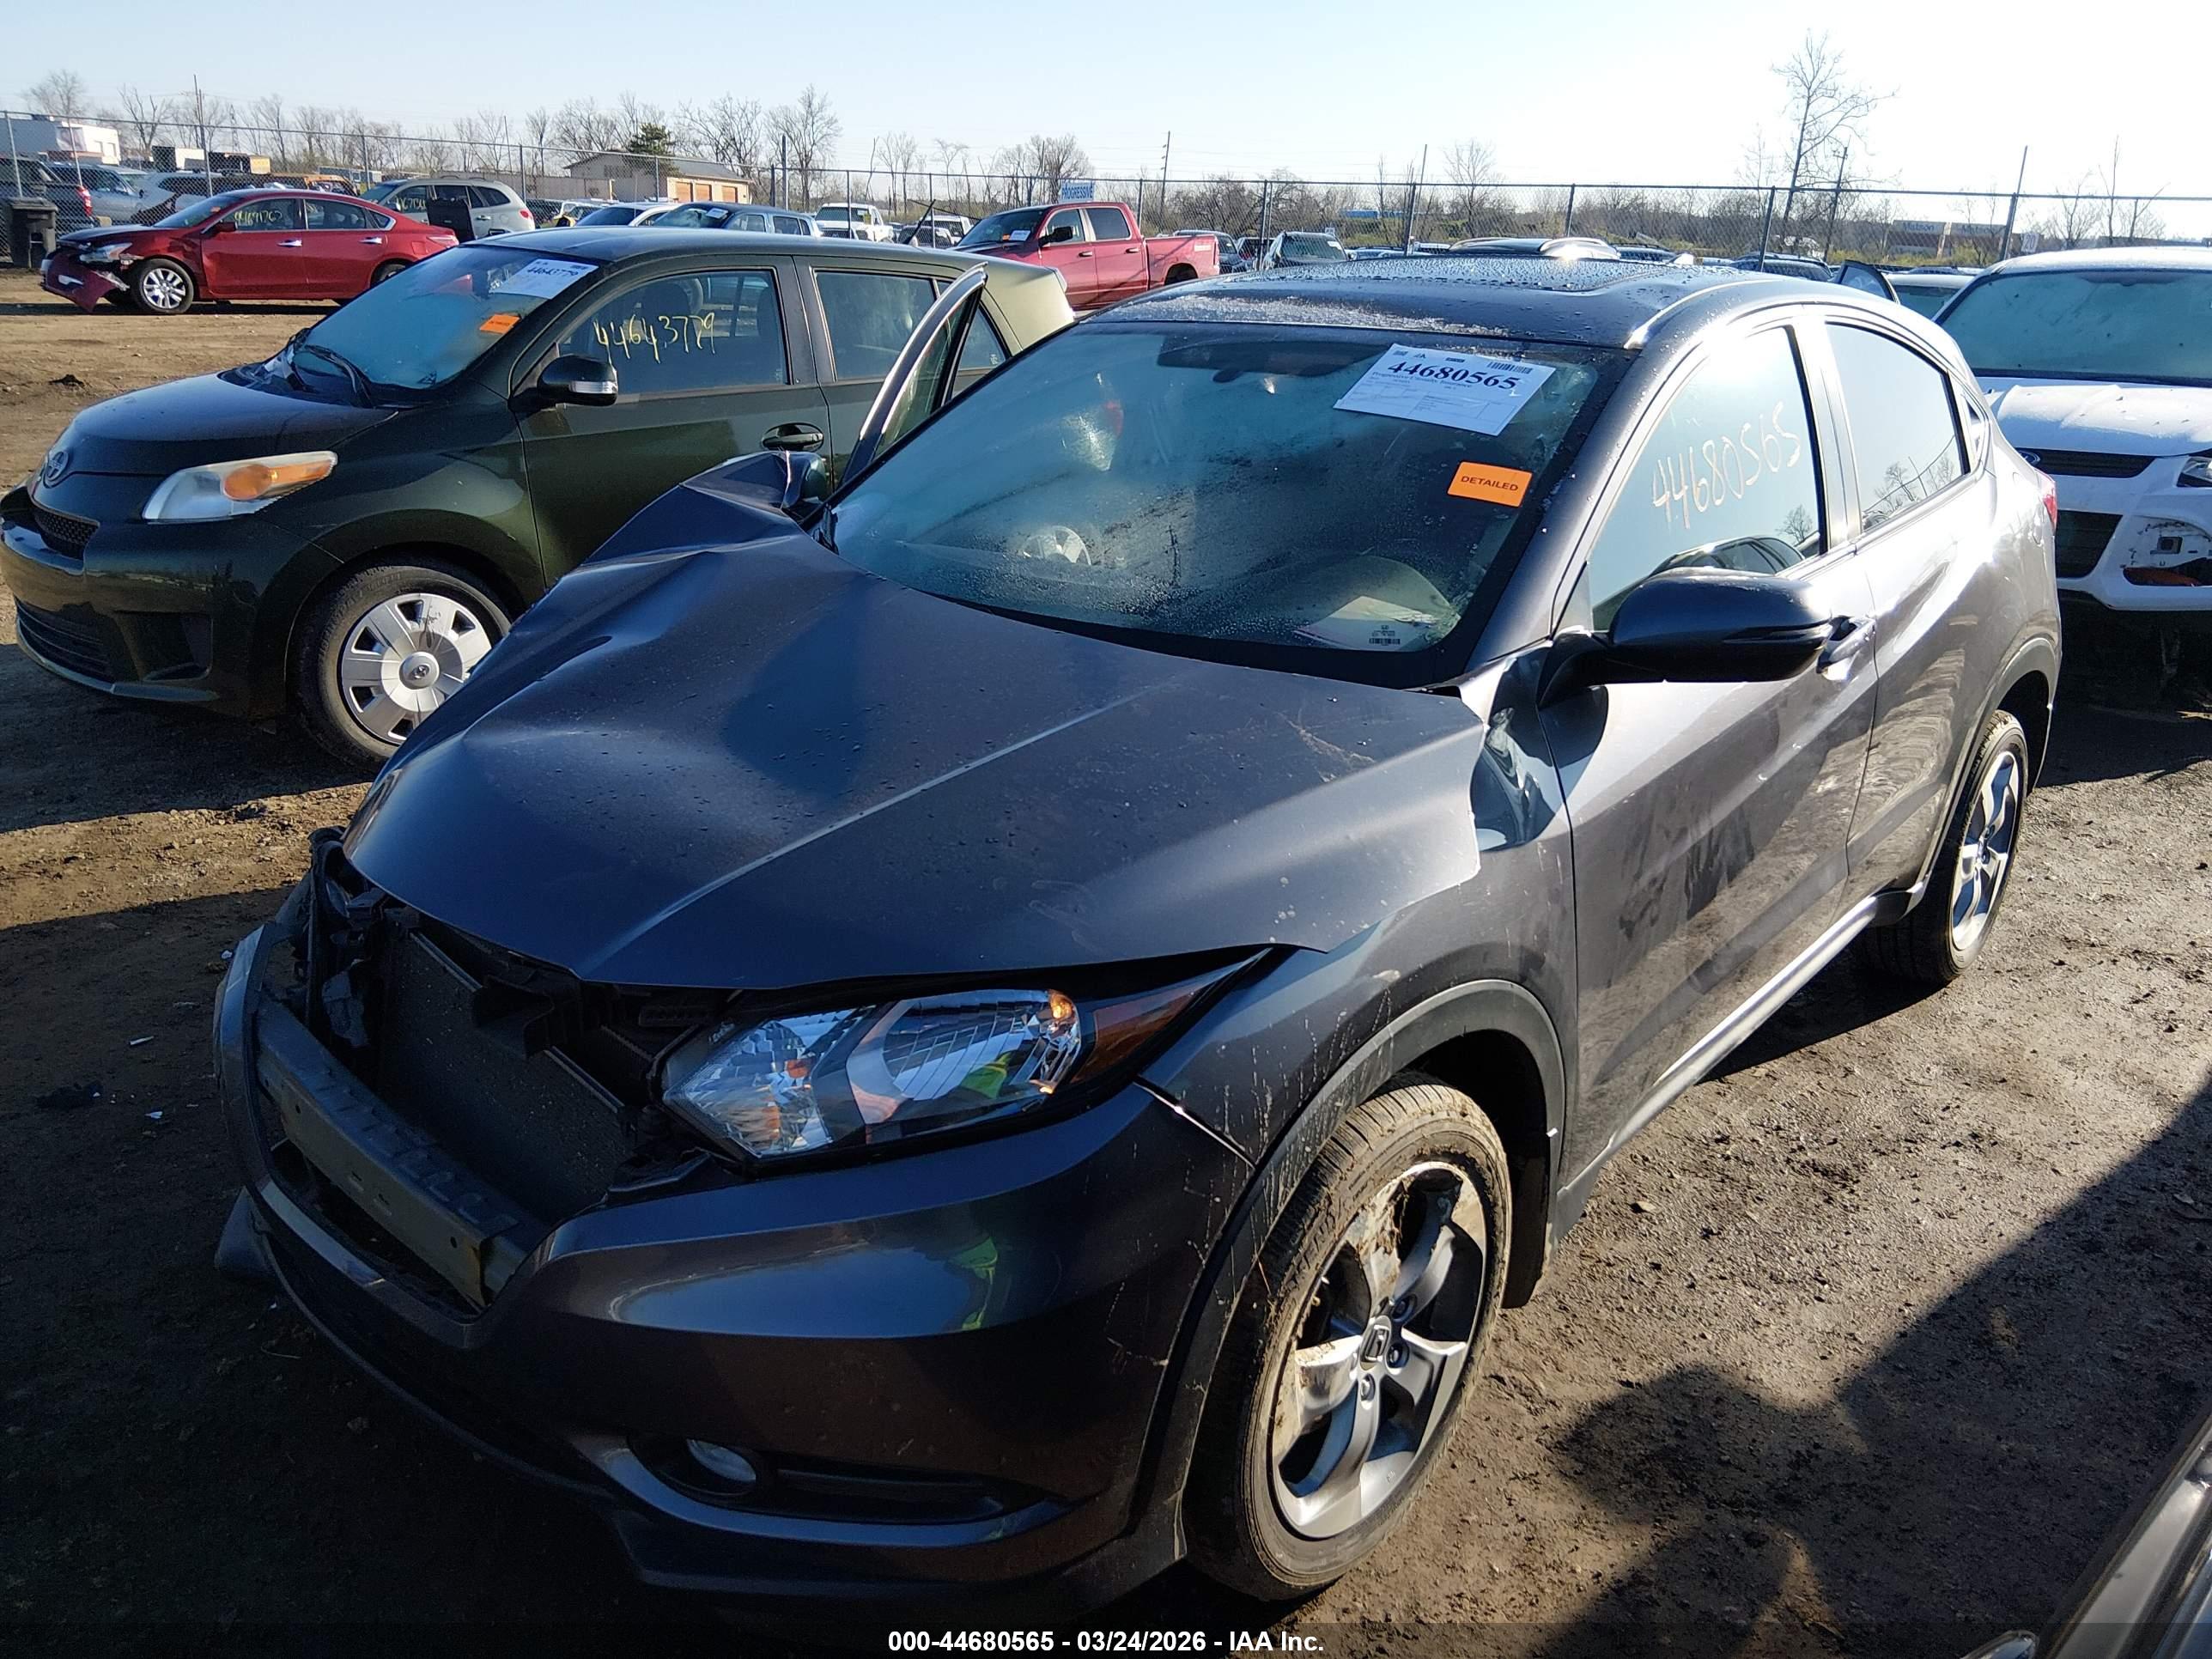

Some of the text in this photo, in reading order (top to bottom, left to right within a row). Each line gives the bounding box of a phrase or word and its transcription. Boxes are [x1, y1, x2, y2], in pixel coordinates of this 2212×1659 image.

[1061, 185, 1093, 199] PROGRESSIVE
[593, 312, 716, 364] 44643779
[1388, 361, 1520, 390] 44680565
[1652, 400, 1802, 530] 44680565
[1461, 476, 1518, 491] DETAILED
